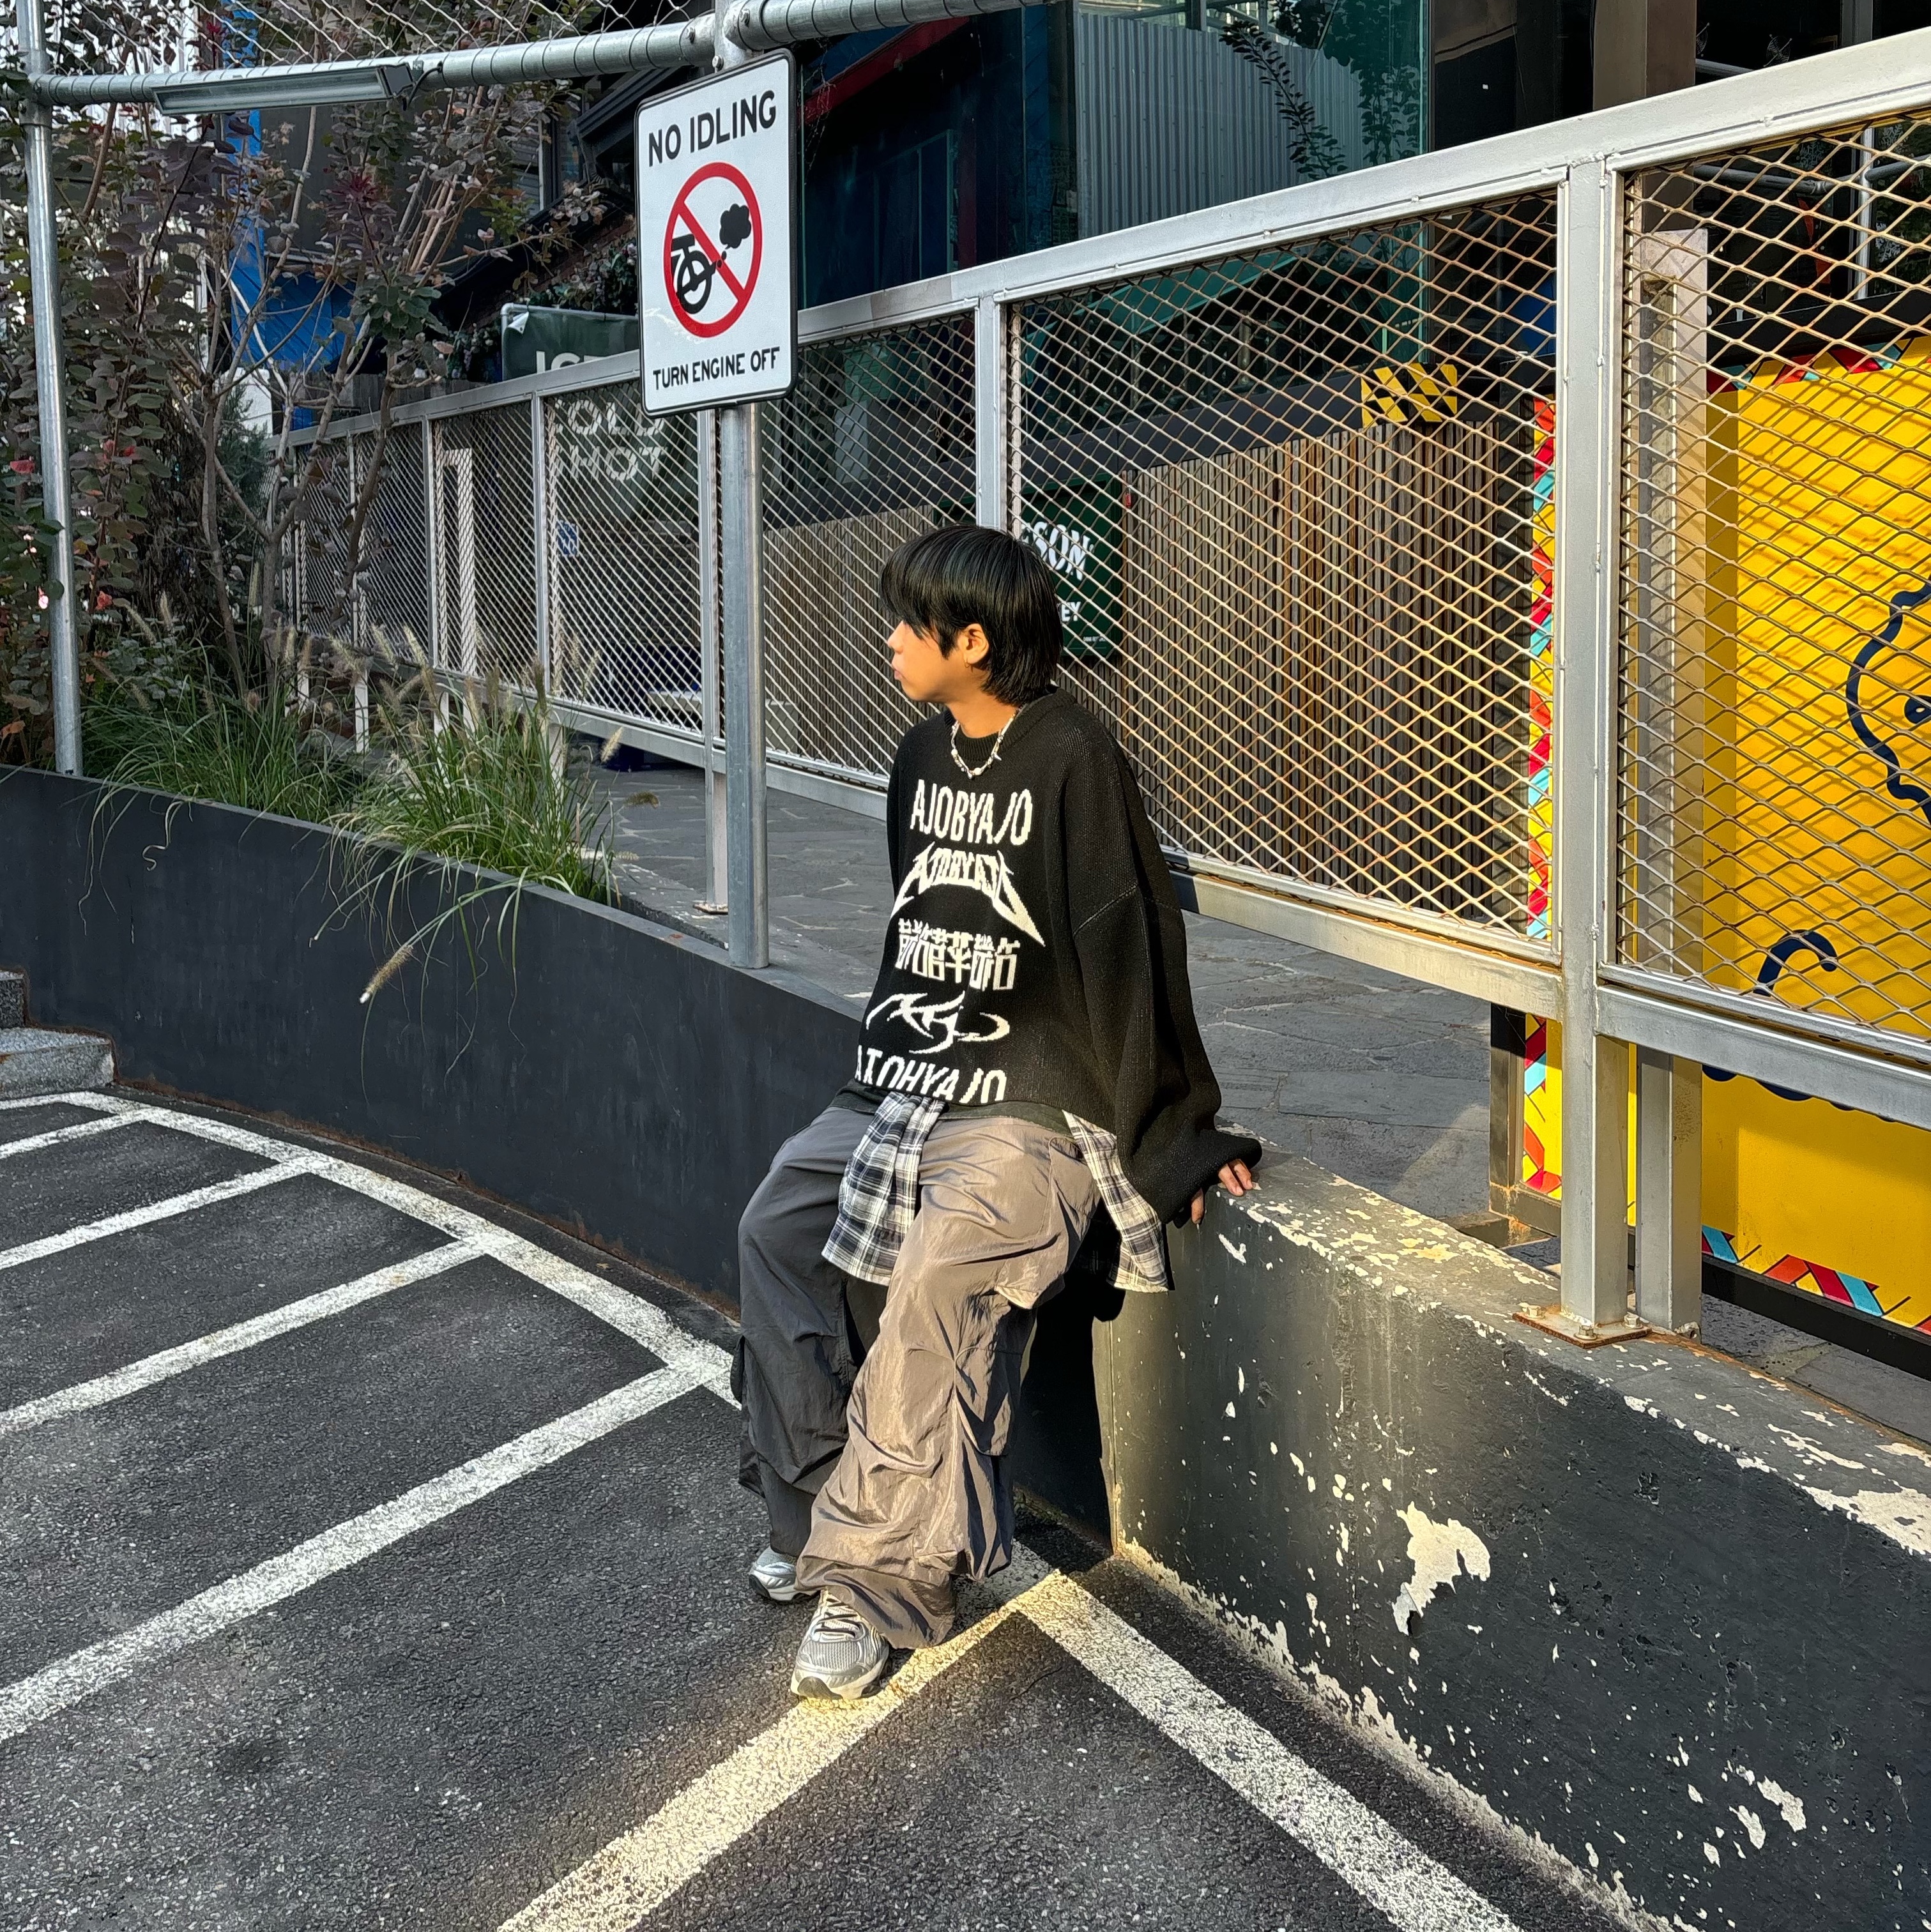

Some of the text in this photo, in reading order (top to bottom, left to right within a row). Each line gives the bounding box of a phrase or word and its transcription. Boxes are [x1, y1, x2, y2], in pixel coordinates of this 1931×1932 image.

[649, 90, 776, 167] NO IDLING
[653, 346, 780, 390] TURN ENGINE OFF
[910, 779, 1034, 846] AJOBYAJO
